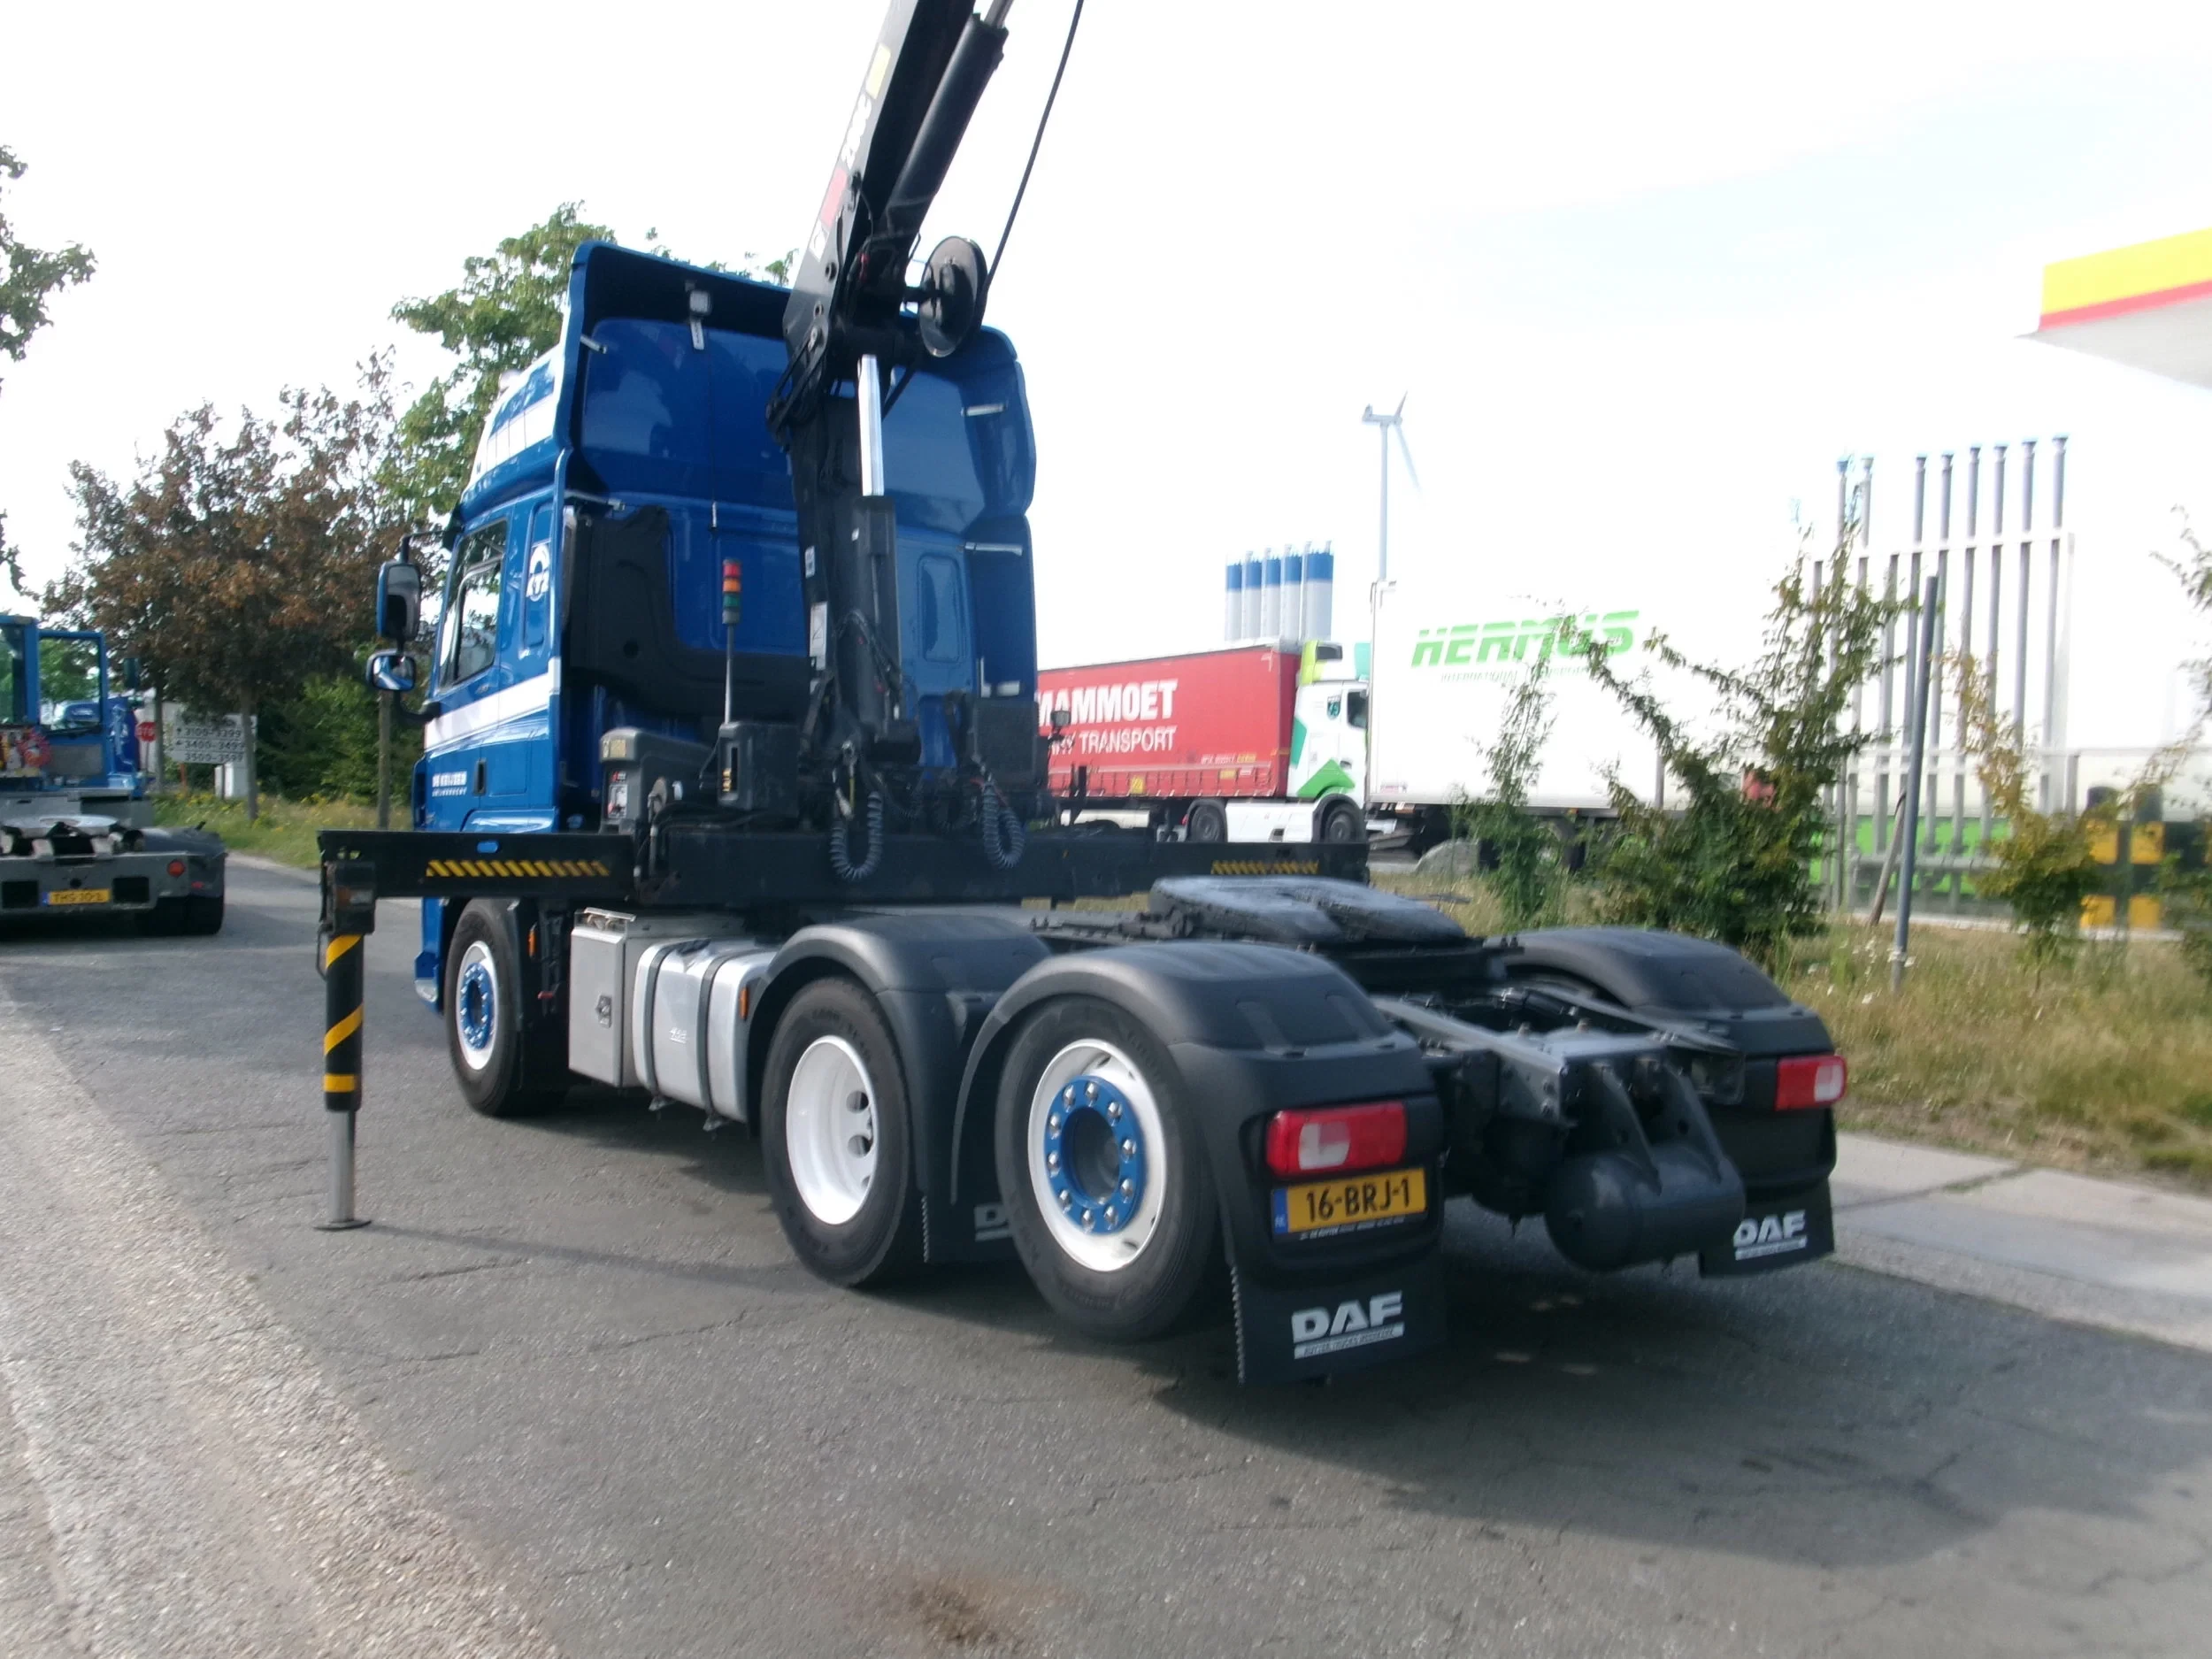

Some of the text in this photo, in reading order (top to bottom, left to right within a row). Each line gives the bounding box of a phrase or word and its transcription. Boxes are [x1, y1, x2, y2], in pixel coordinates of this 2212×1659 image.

[1411, 610, 1640, 668] HERMUS
[1038, 679, 1179, 727] MAMMOET
[1078, 725, 1178, 756] TRANSPORT
[1306, 1176, 1410, 1223] 16-BRJ-1
[1733, 1210, 1806, 1248] DAF
[1291, 1290, 1403, 1343] DAF
